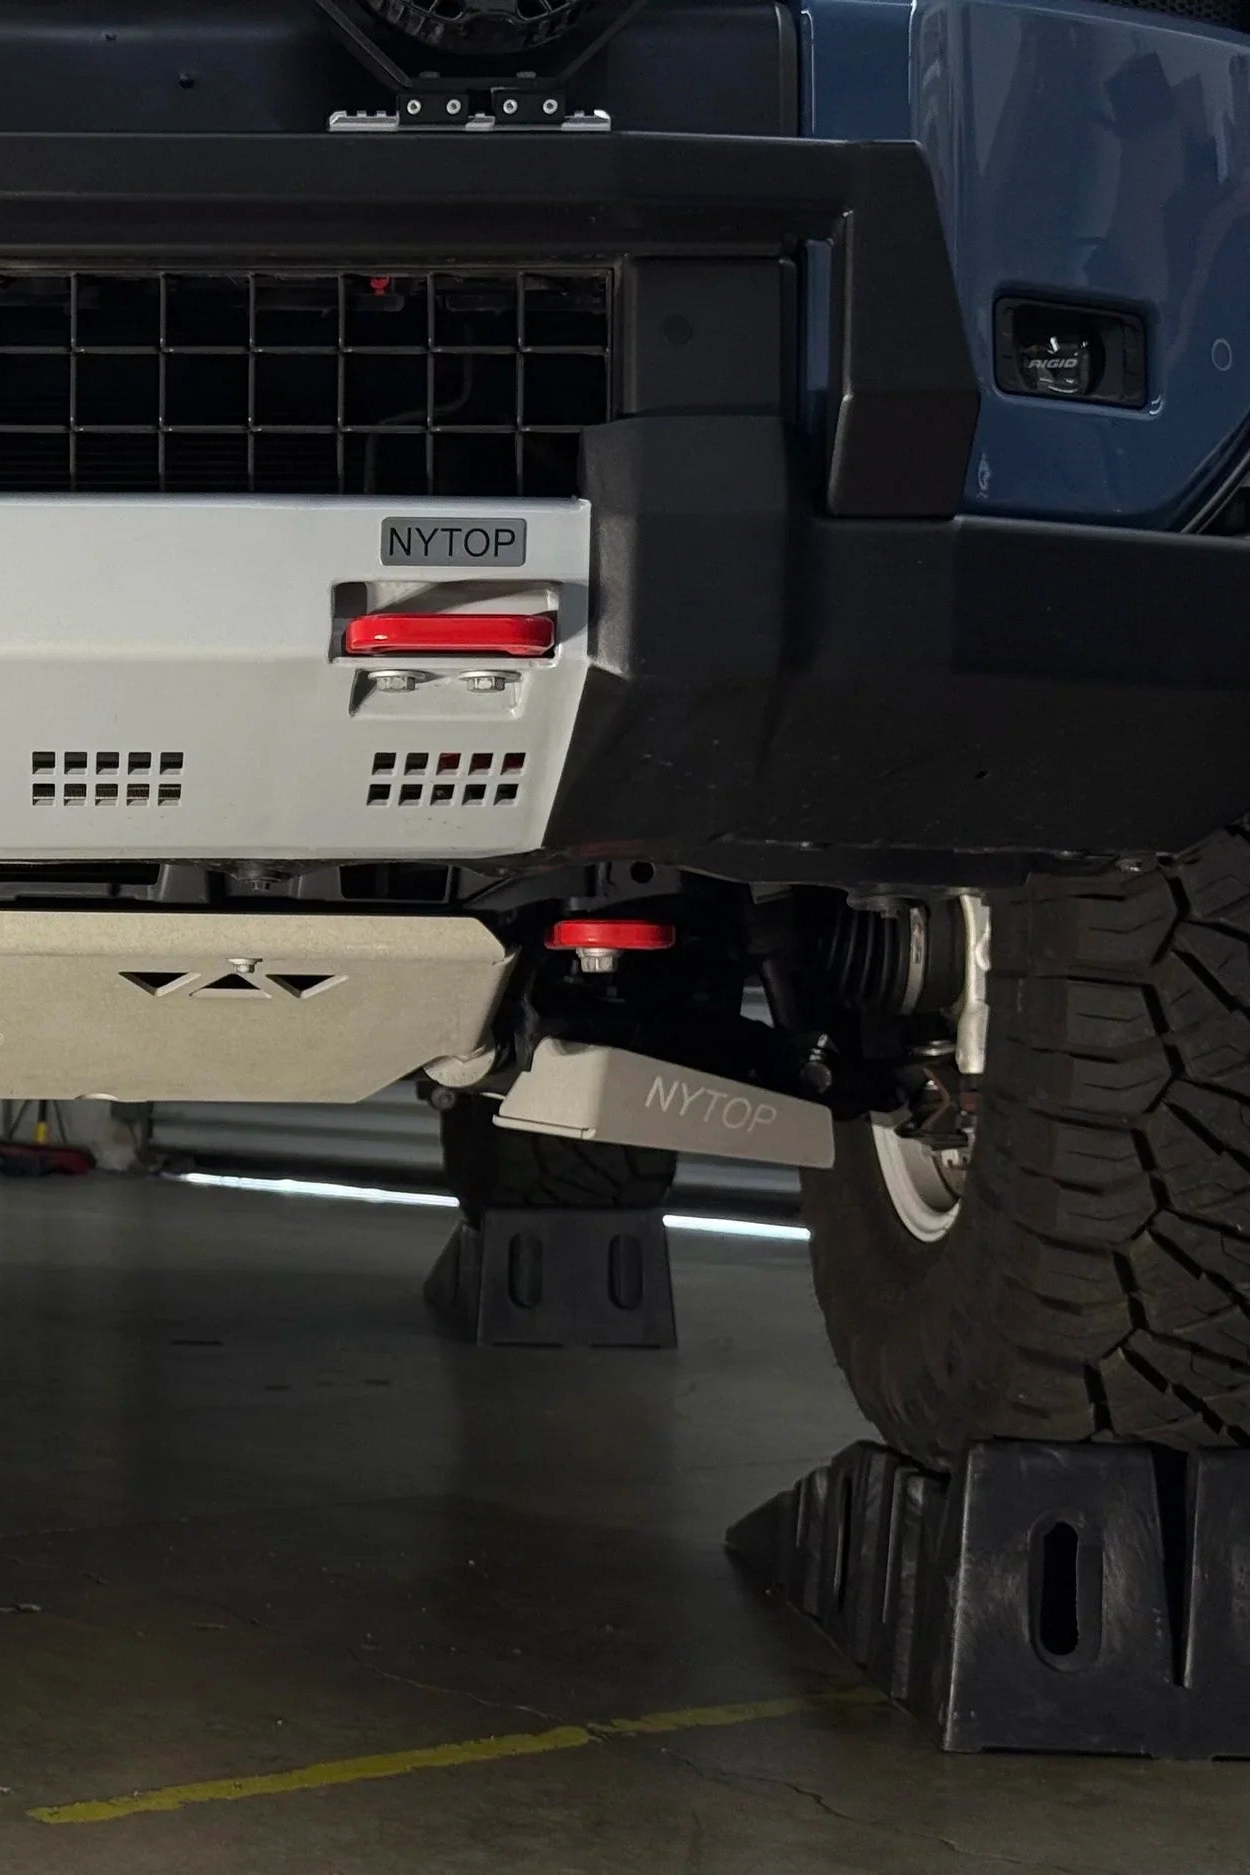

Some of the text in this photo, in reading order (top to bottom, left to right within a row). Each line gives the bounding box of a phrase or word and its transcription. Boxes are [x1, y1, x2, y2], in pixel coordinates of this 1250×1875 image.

[1027, 358, 1078, 369] RIGID
[388, 527, 516, 558] NYTOP
[644, 1075, 778, 1133] NYTOP
